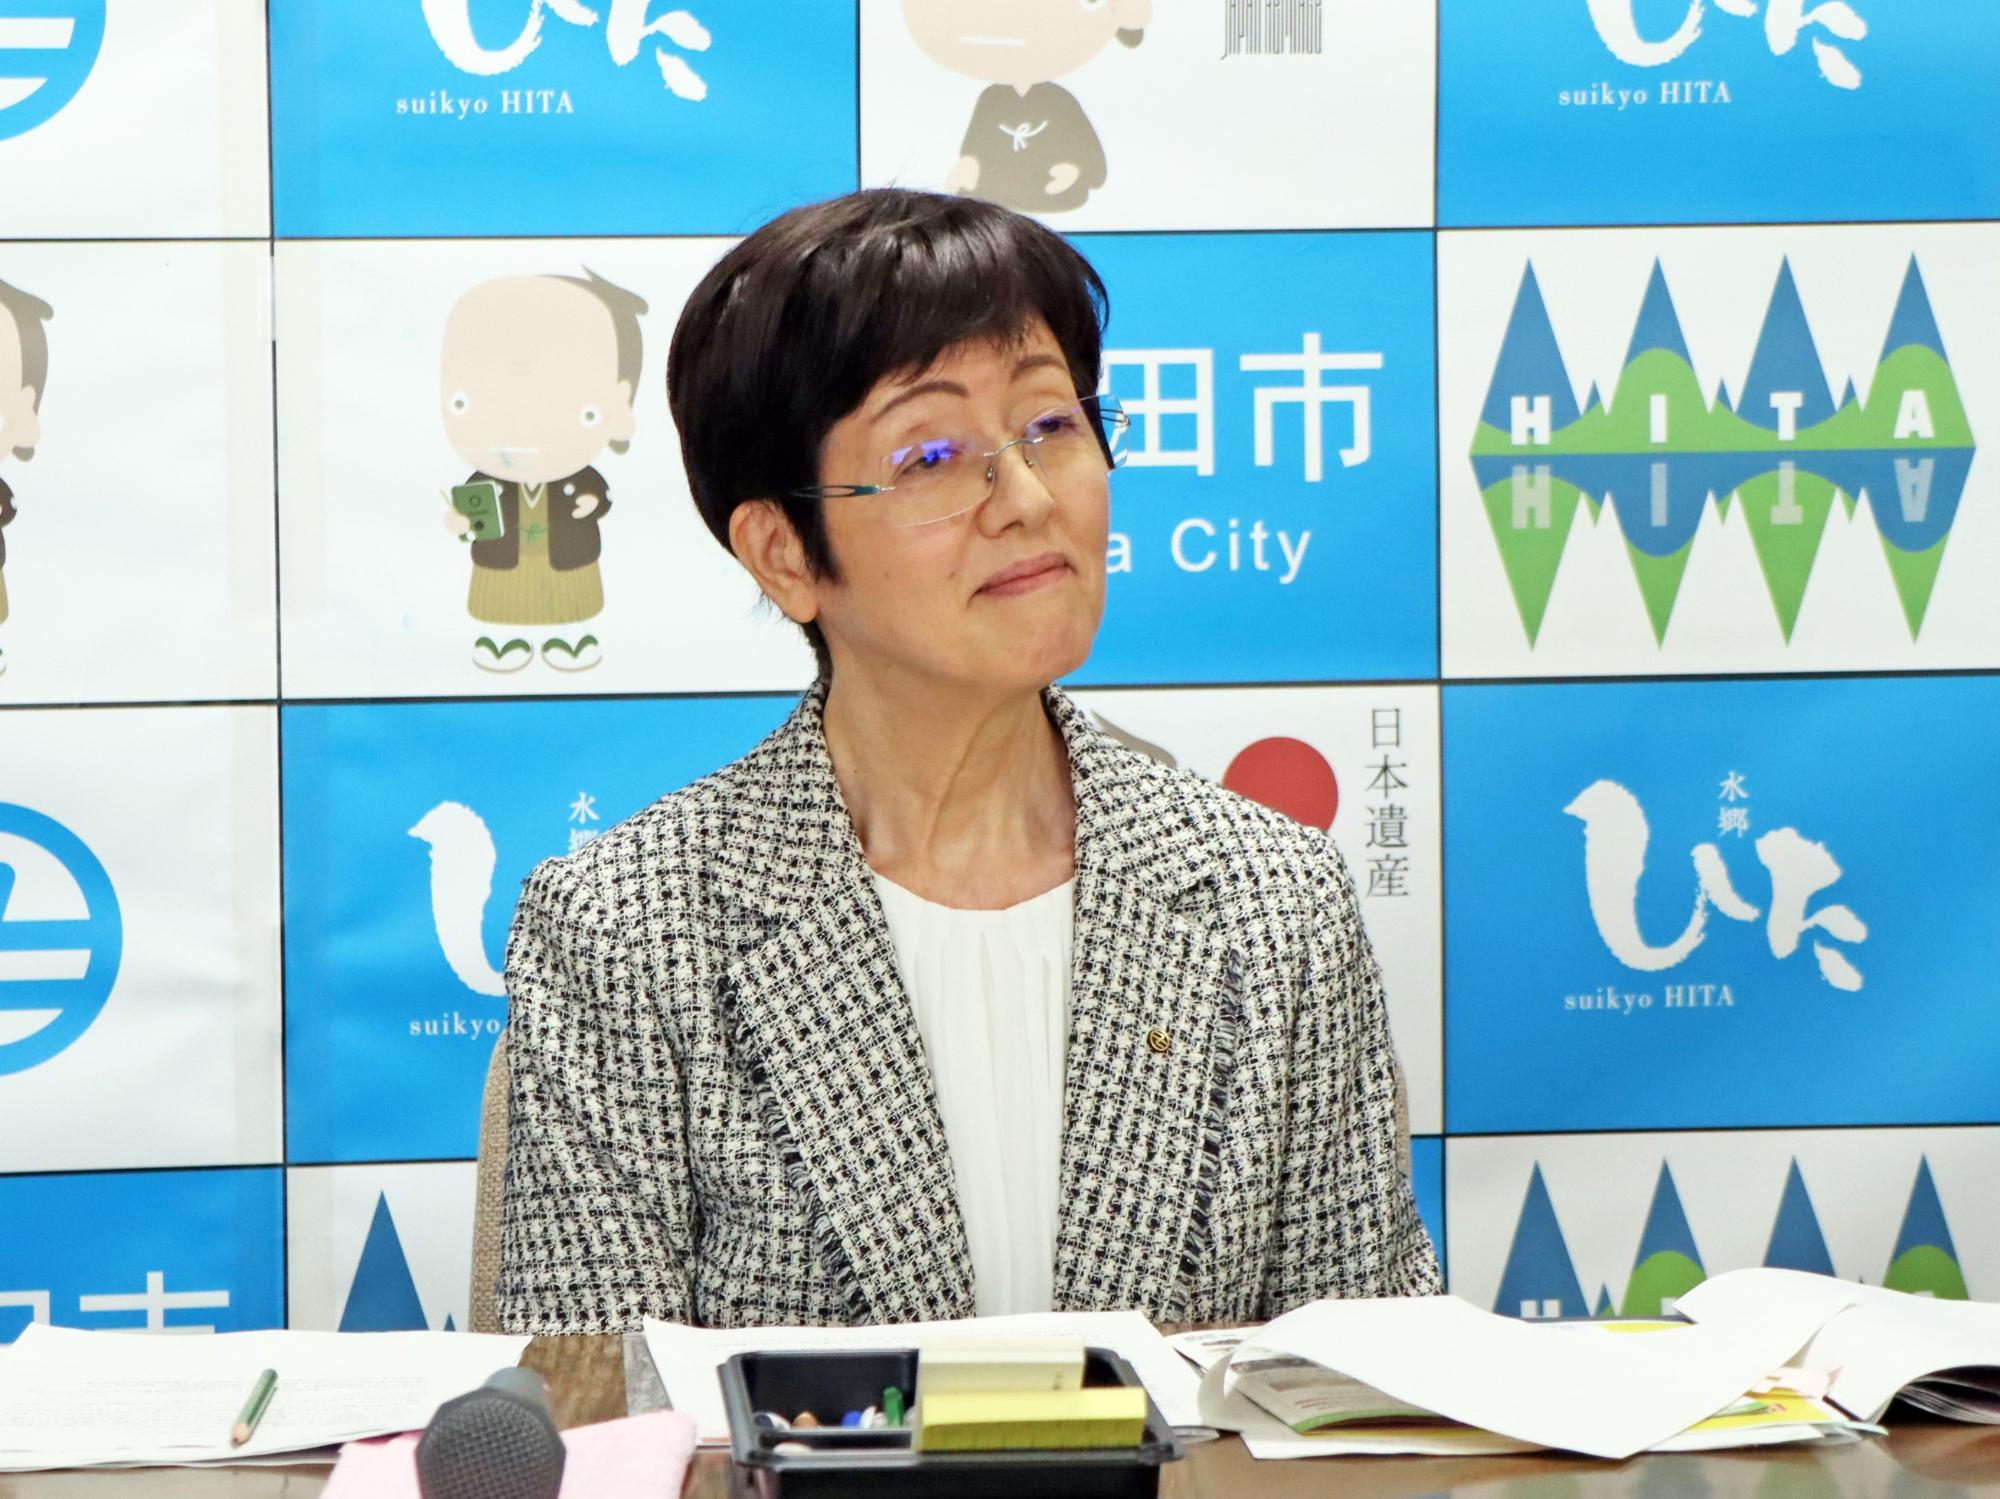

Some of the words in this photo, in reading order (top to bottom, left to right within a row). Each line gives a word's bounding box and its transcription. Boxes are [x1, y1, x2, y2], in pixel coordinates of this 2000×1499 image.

[396, 91, 489, 120] suikyo
[501, 89, 575, 113] HITA
[1558, 82, 1648, 110] suikyo
[1660, 80, 1732, 104] HITA
[1097, 332, 1384, 482] 田市
[1511, 389, 1935, 446] HITA
[1170, 517, 1312, 585] City
[1365, 708, 1410, 899] 日本遺産
[1719, 770, 1750, 838] 水郷
[409, 1010, 501, 1041] suikyo
[1564, 987, 1654, 1014] suikyo
[1664, 984, 1736, 1008] HITA
